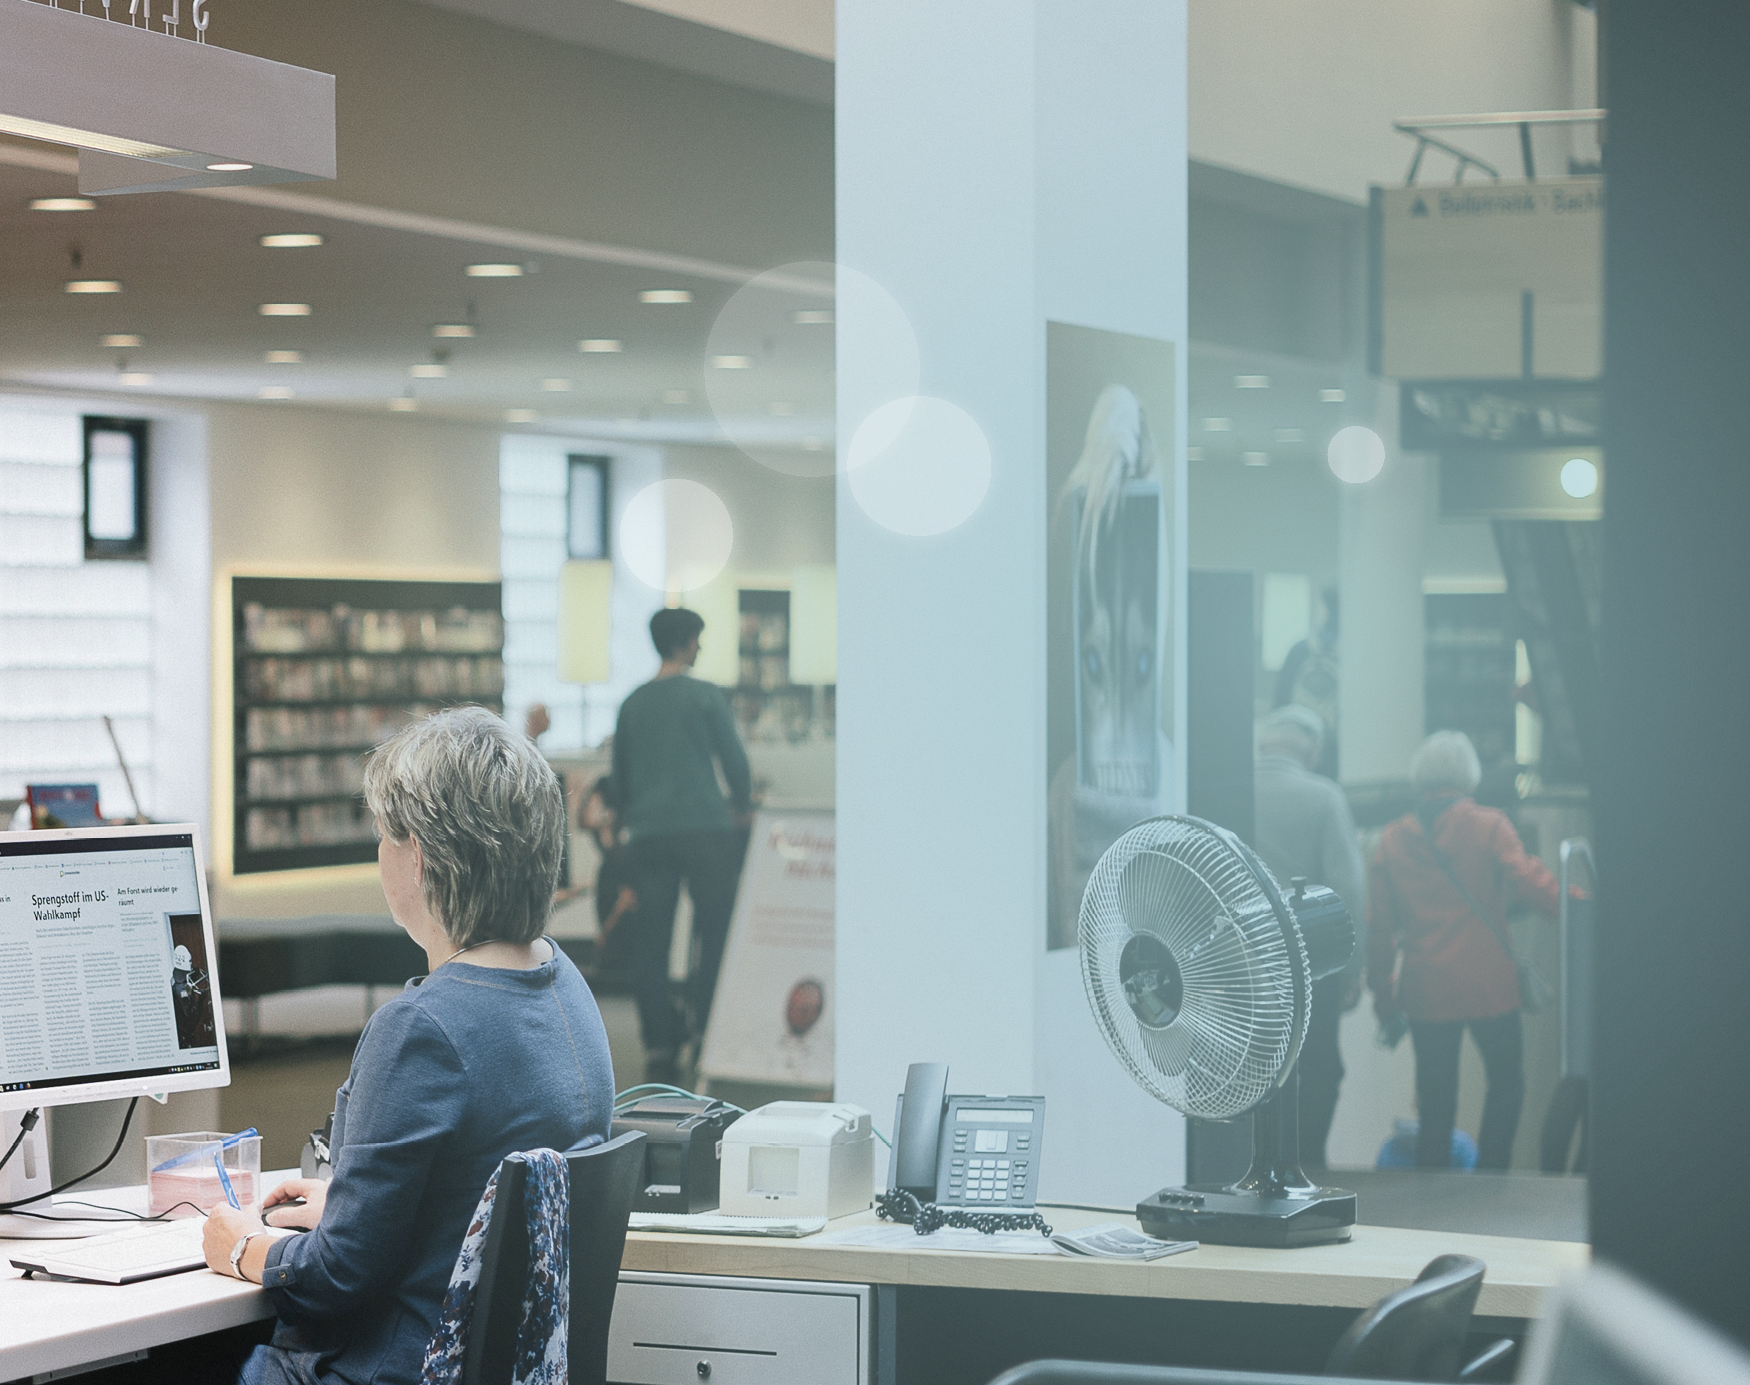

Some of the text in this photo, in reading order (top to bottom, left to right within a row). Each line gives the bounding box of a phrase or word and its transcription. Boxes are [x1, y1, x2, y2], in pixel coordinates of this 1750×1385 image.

[126, 886, 140, 894] Forst
[141, 886, 152, 894] wird
[170, 886, 179, 894] ge-
[32, 890, 109, 908] Sprengstoff im US-
[33, 908, 81, 922] Wahlkampf
